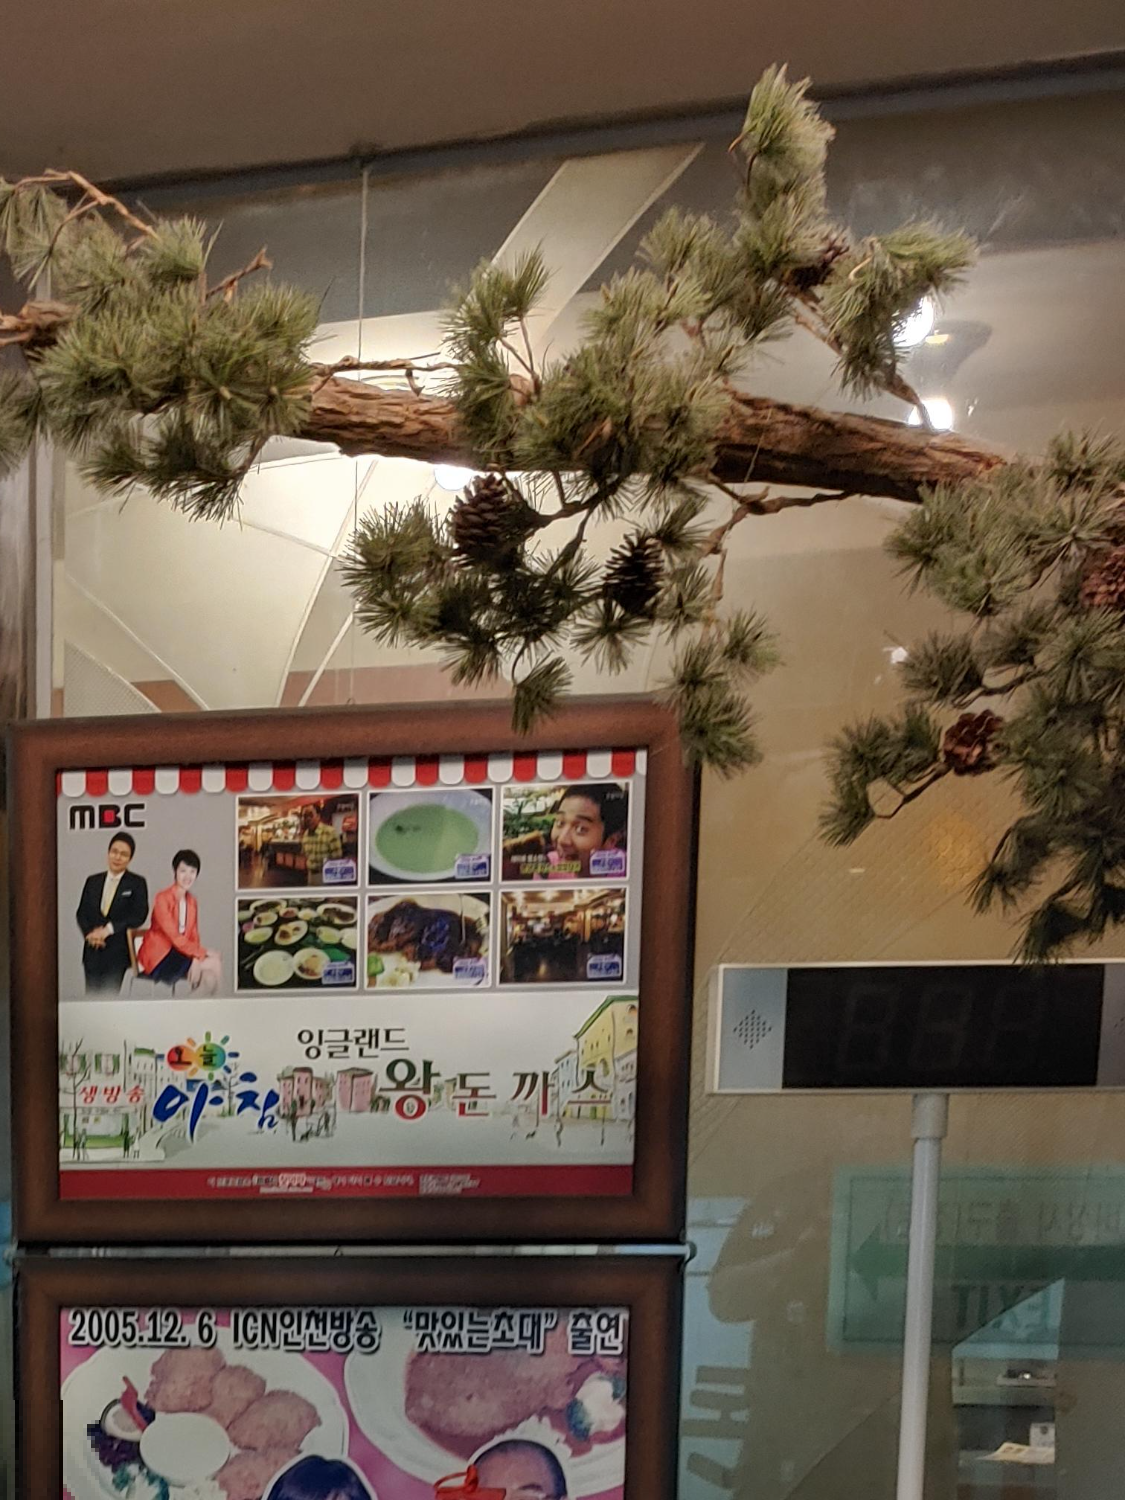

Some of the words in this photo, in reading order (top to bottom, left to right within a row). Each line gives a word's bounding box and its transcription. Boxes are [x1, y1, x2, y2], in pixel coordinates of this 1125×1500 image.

[69, 803, 145, 830] MBC
[167, 1044, 221, 1068] 오늘
[297, 1028, 410, 1060] 잉글랜드
[79, 1084, 145, 1105] 생방송
[152, 1072, 280, 1144] 아침
[570, 1311, 621, 1351] 출연
